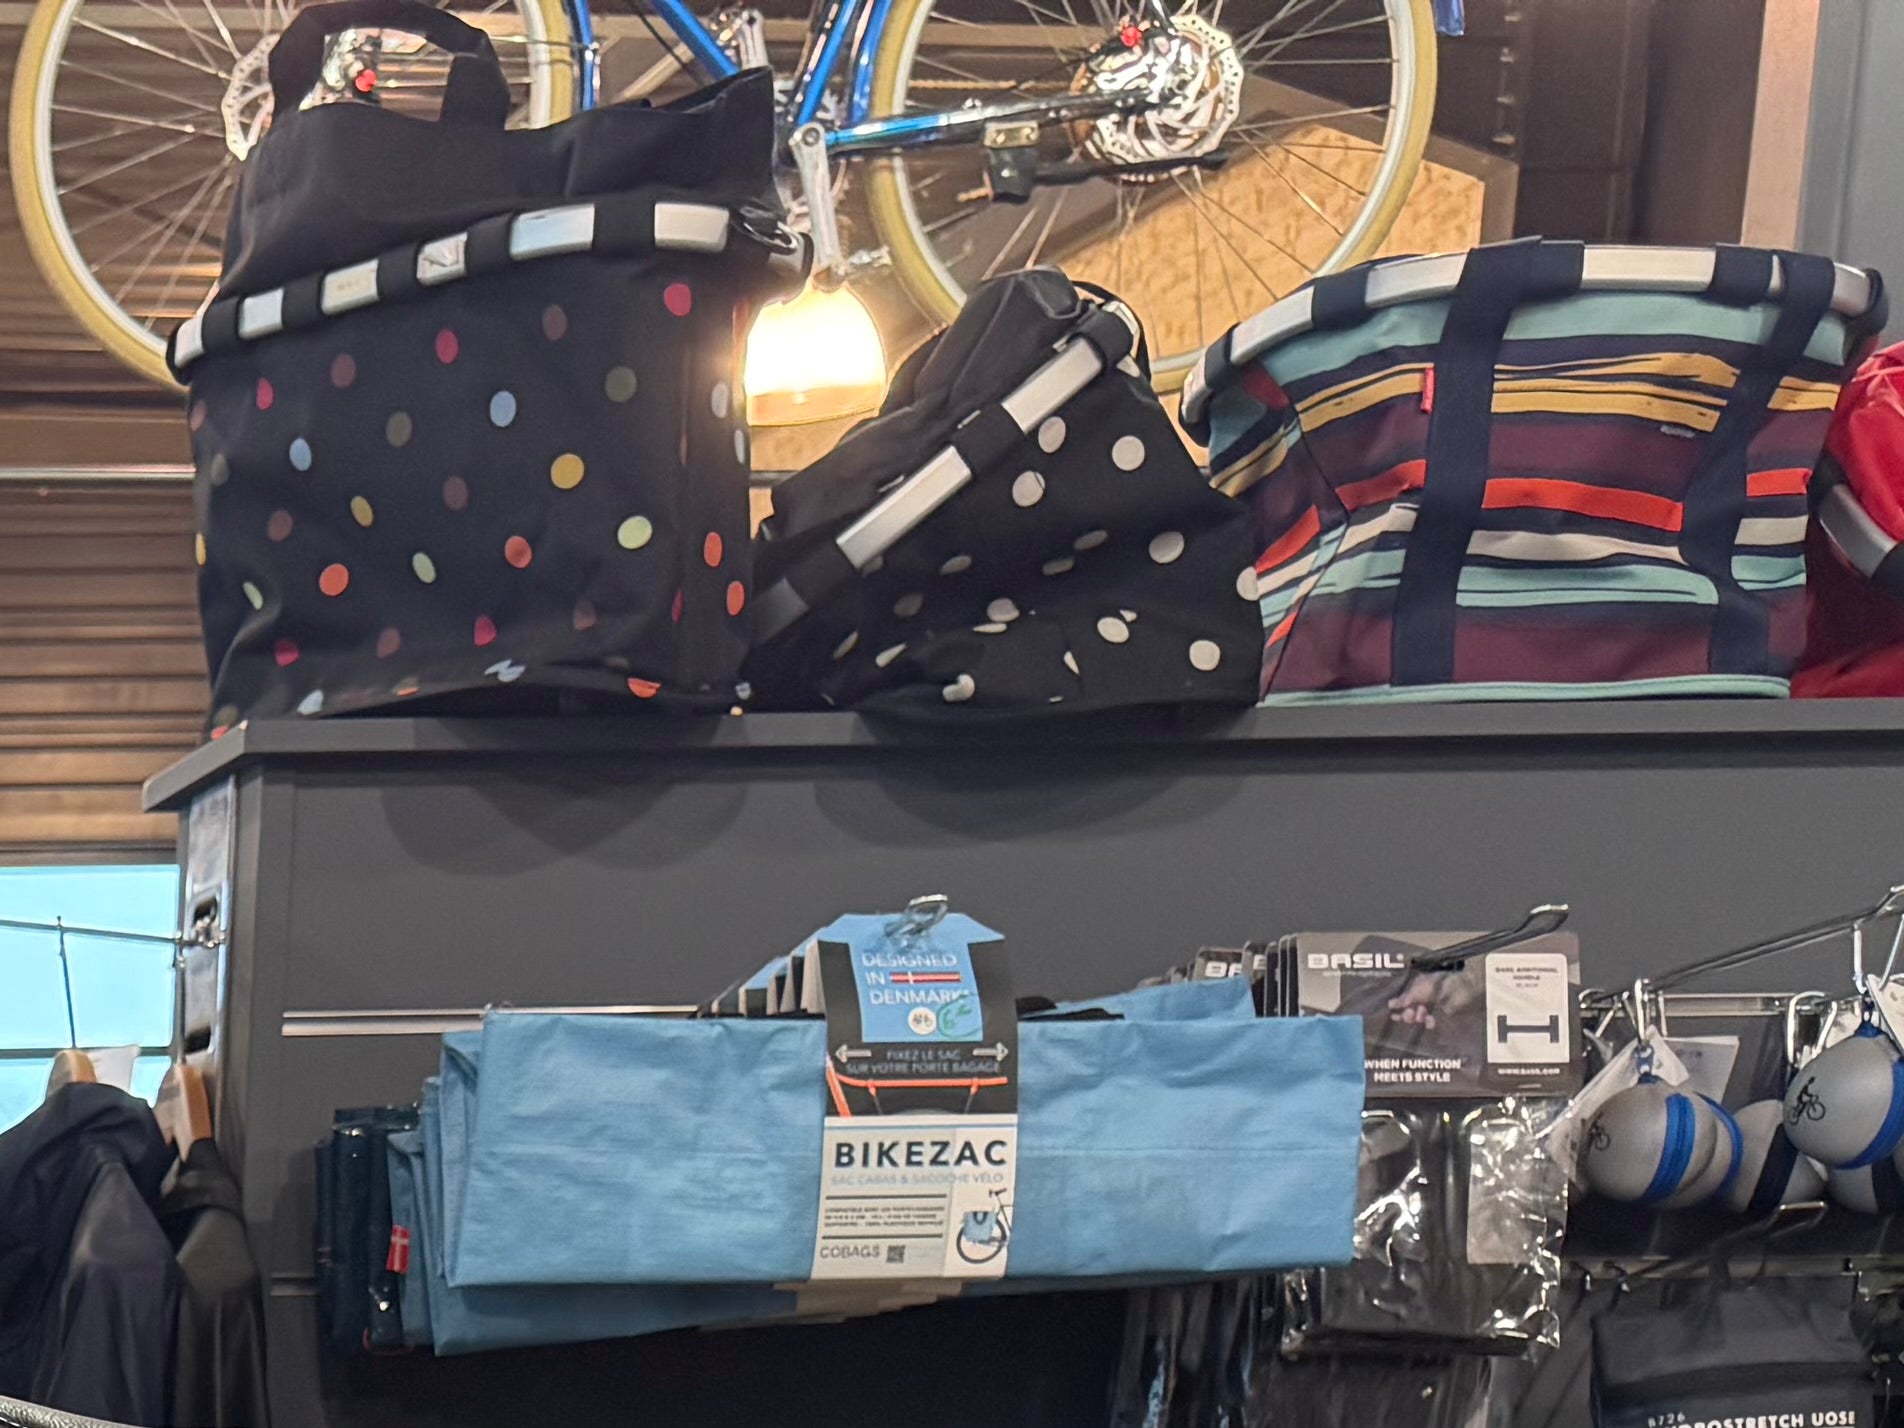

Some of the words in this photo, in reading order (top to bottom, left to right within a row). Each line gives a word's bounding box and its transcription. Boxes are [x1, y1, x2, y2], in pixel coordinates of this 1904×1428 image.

[861, 953, 957, 967] DESIGNED
[1307, 952, 1399, 970] BASIL
[866, 973, 885, 985] IN
[1364, 1059, 1398, 1070] WHEN
[1401, 1058, 1461, 1070] FUNCTION
[1374, 1071, 1412, 1082] MEETS
[1415, 1071, 1450, 1082] STYLE
[834, 1139, 1007, 1168] BIKEZAC
[819, 1245, 880, 1259] COBAGS
